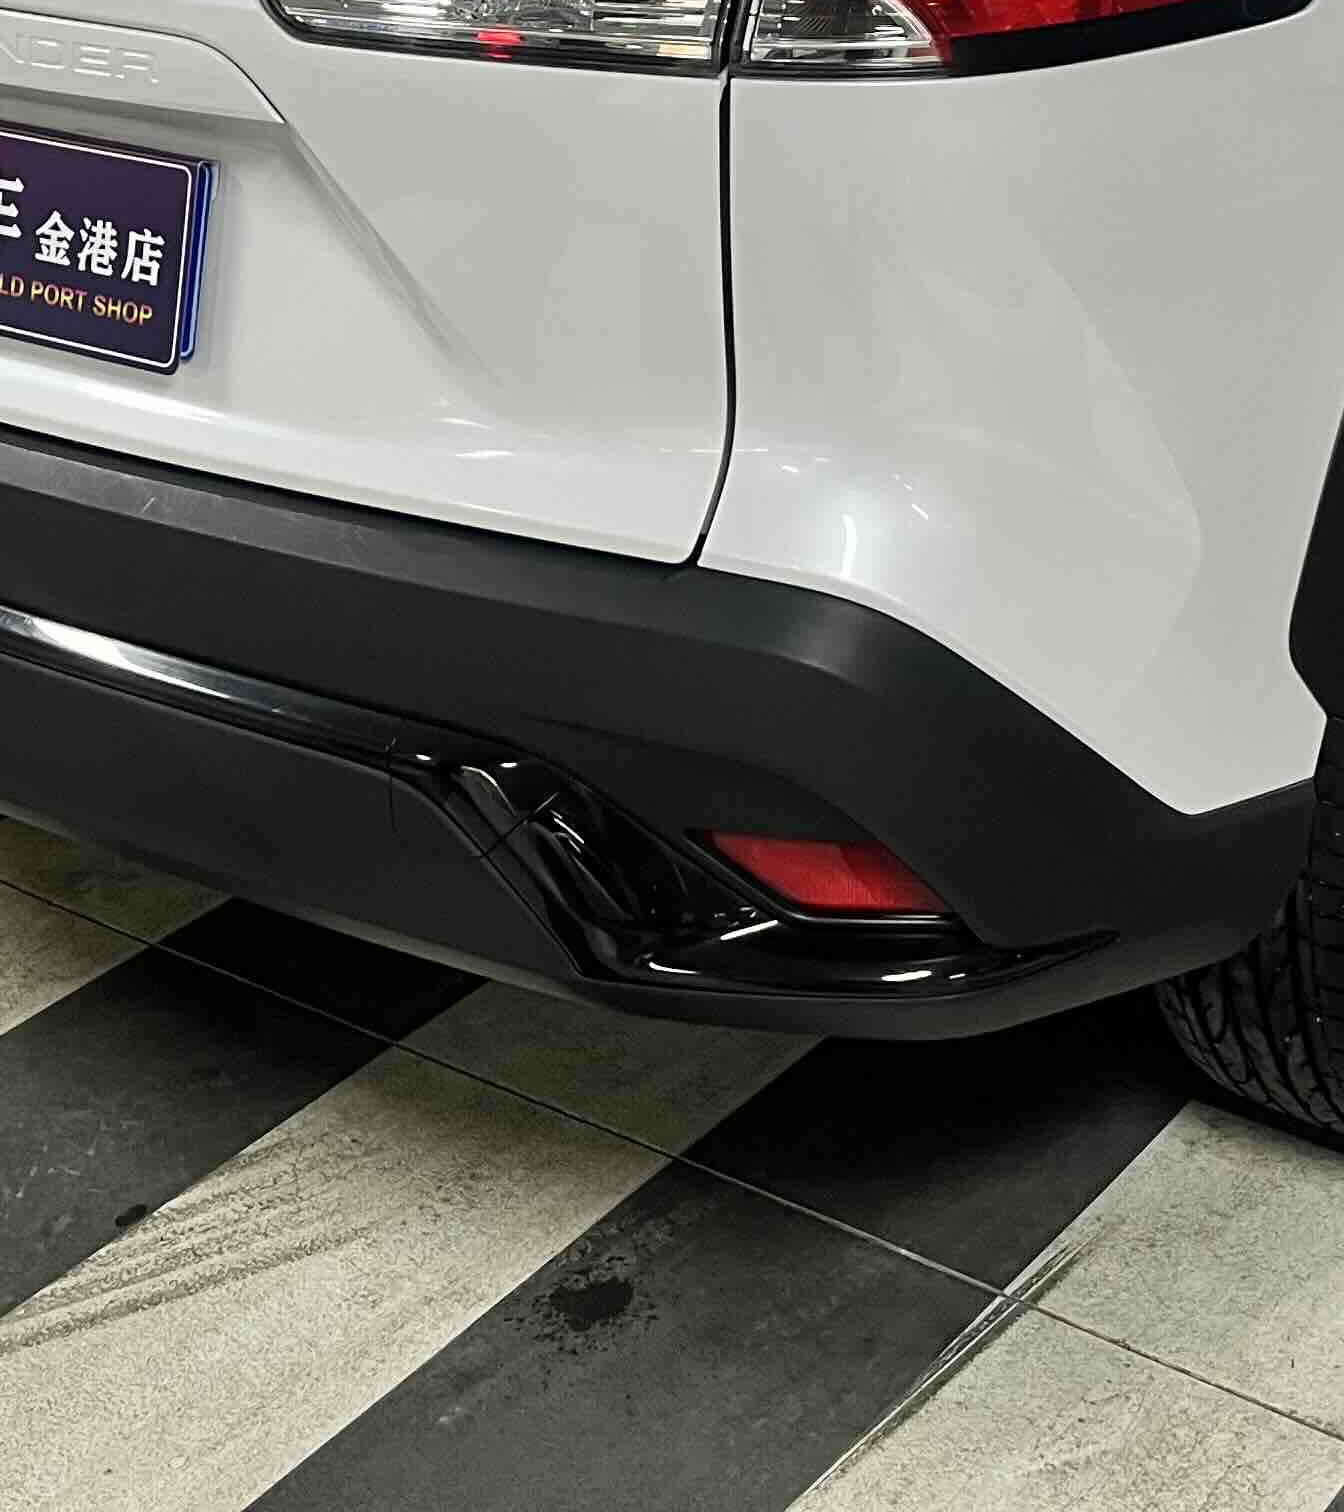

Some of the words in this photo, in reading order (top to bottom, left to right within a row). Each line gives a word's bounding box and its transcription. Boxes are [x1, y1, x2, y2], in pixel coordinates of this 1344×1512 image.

[35, 210, 165, 287] 金港店
[31, 281, 88, 314] PORT
[94, 295, 154, 327] SHOP
